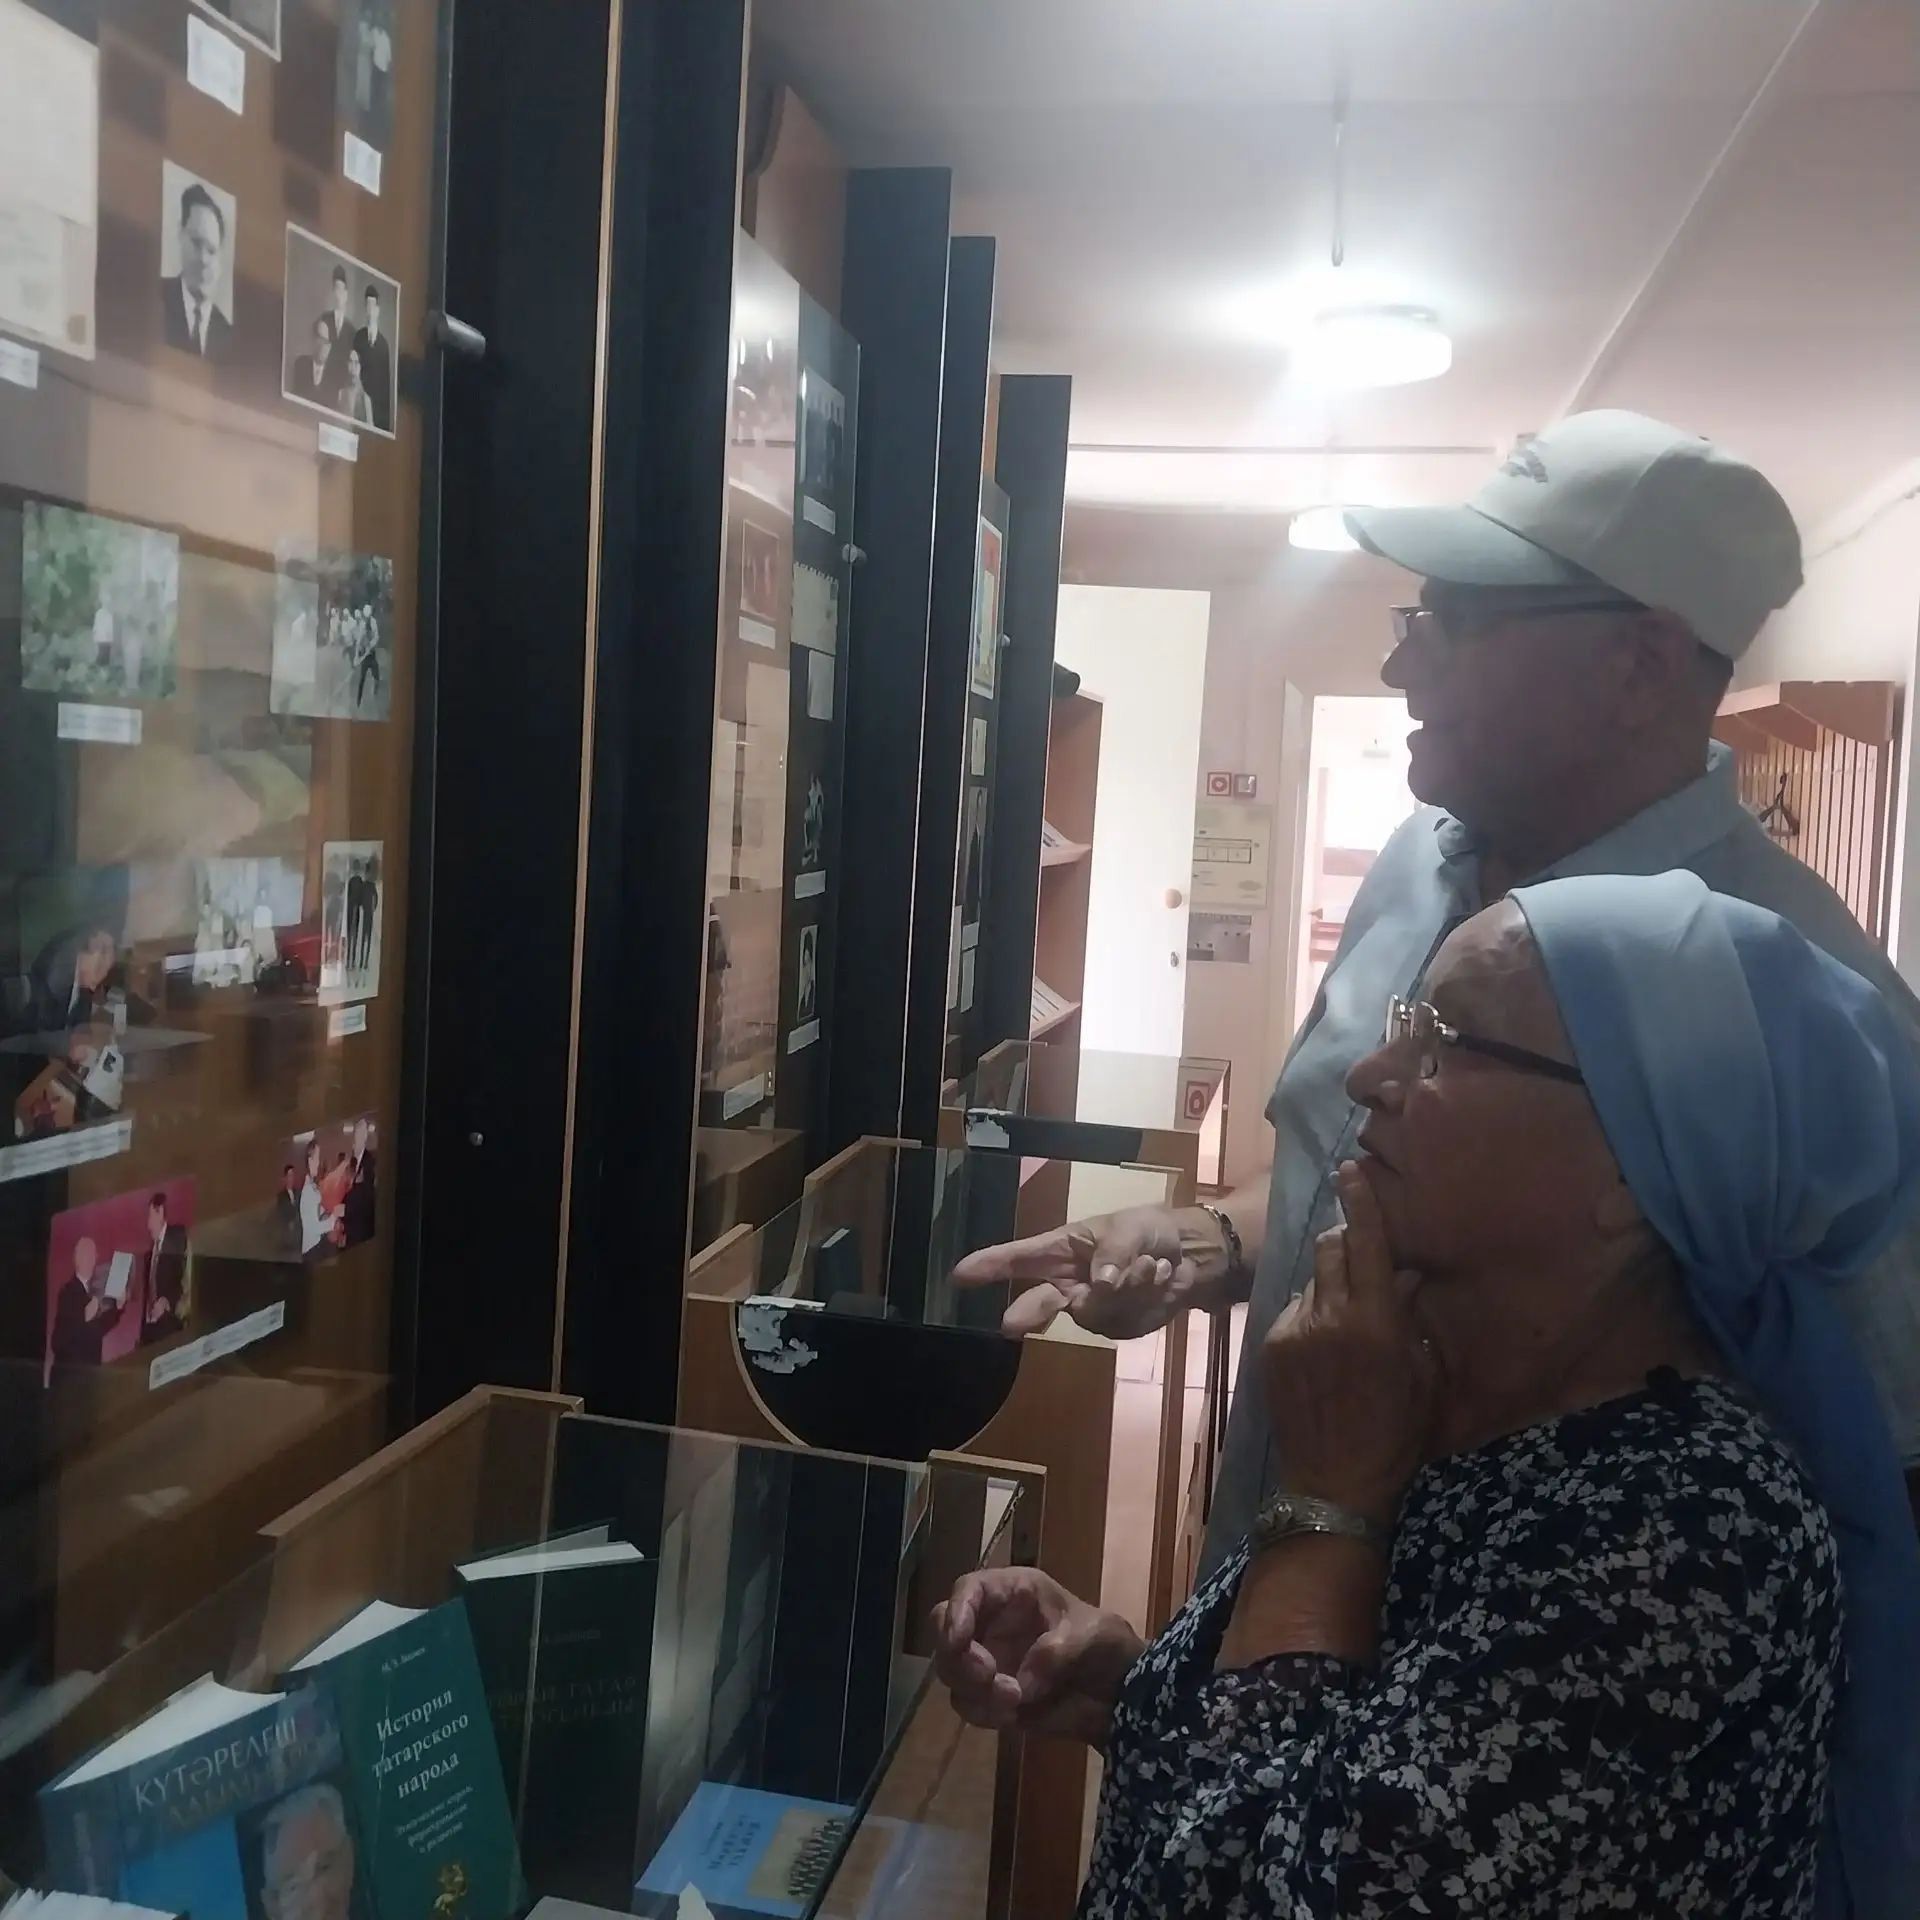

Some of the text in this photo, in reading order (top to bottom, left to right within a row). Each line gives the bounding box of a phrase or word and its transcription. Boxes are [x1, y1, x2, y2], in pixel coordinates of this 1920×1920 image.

[375, 1689, 453, 1742] История
[371, 1714, 469, 1779] татарского
[397, 1752, 460, 1800] народа
